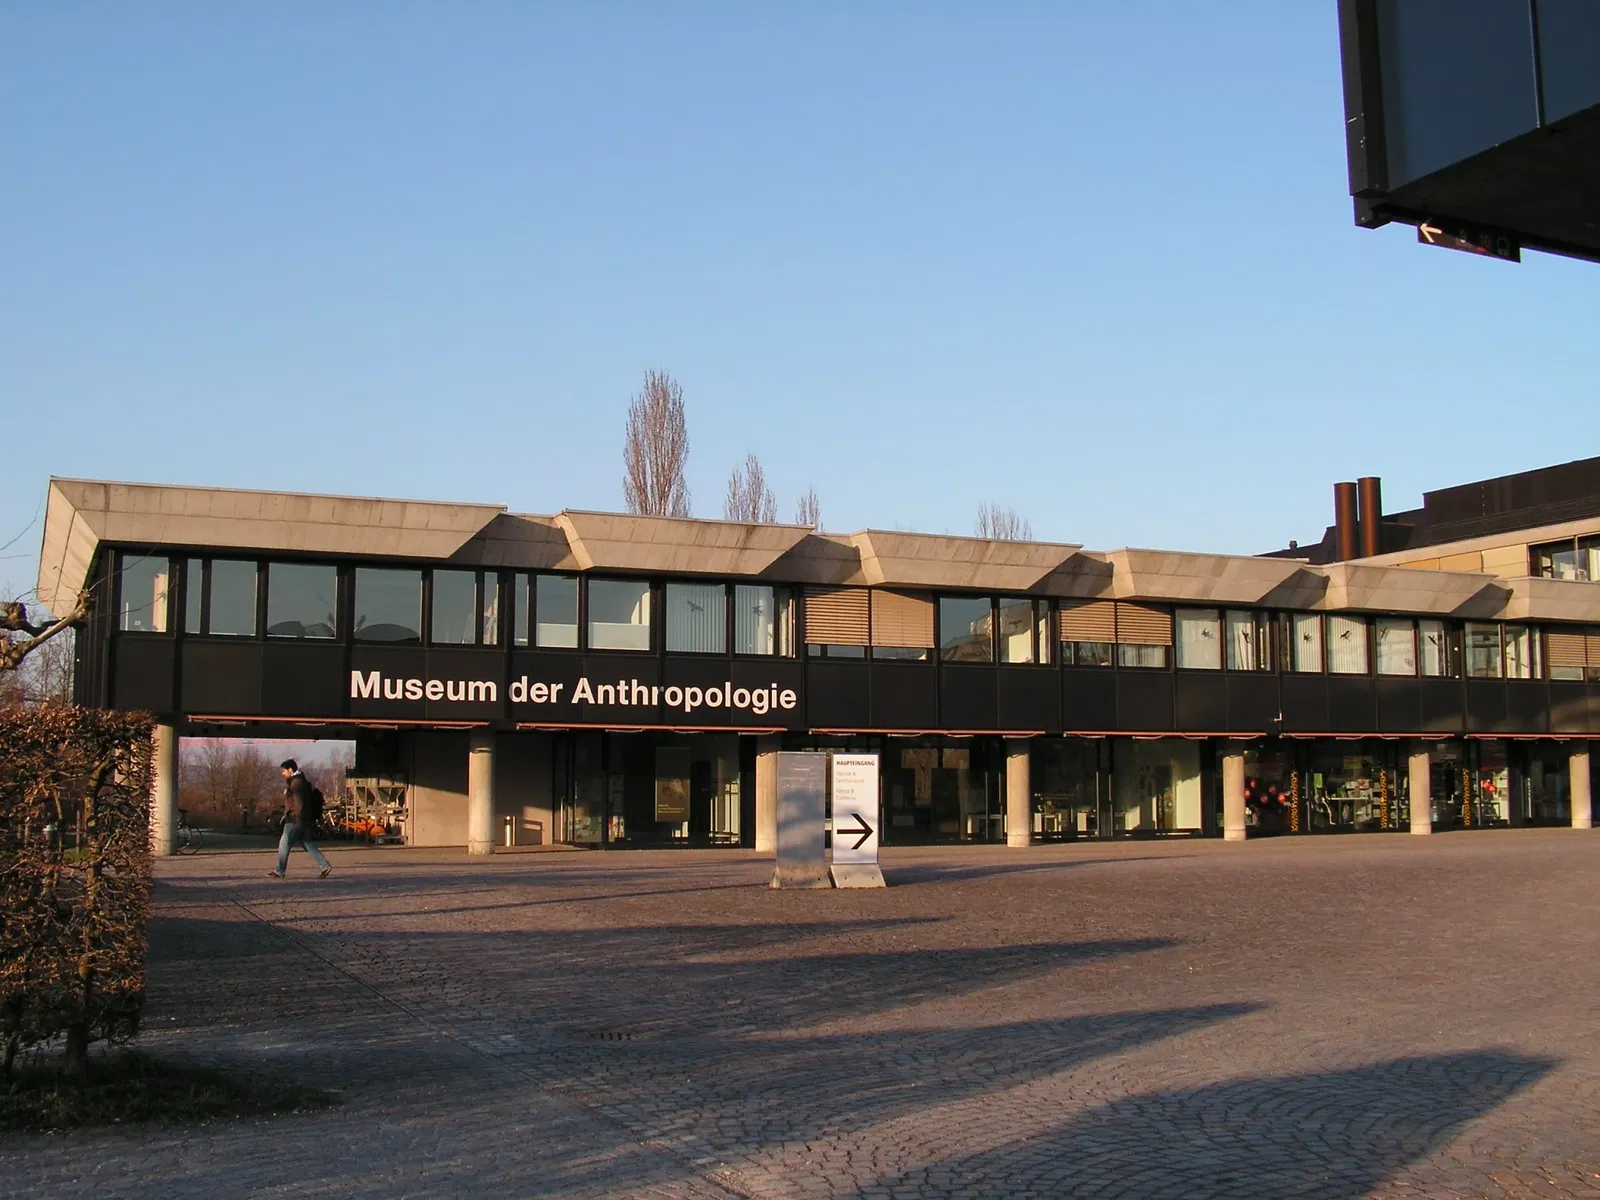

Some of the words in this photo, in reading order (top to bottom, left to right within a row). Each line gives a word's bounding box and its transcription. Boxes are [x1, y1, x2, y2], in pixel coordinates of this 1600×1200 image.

[350, 670, 497, 702] Museum
[508, 675, 564, 704] der
[571, 677, 797, 714] Anthropologie
